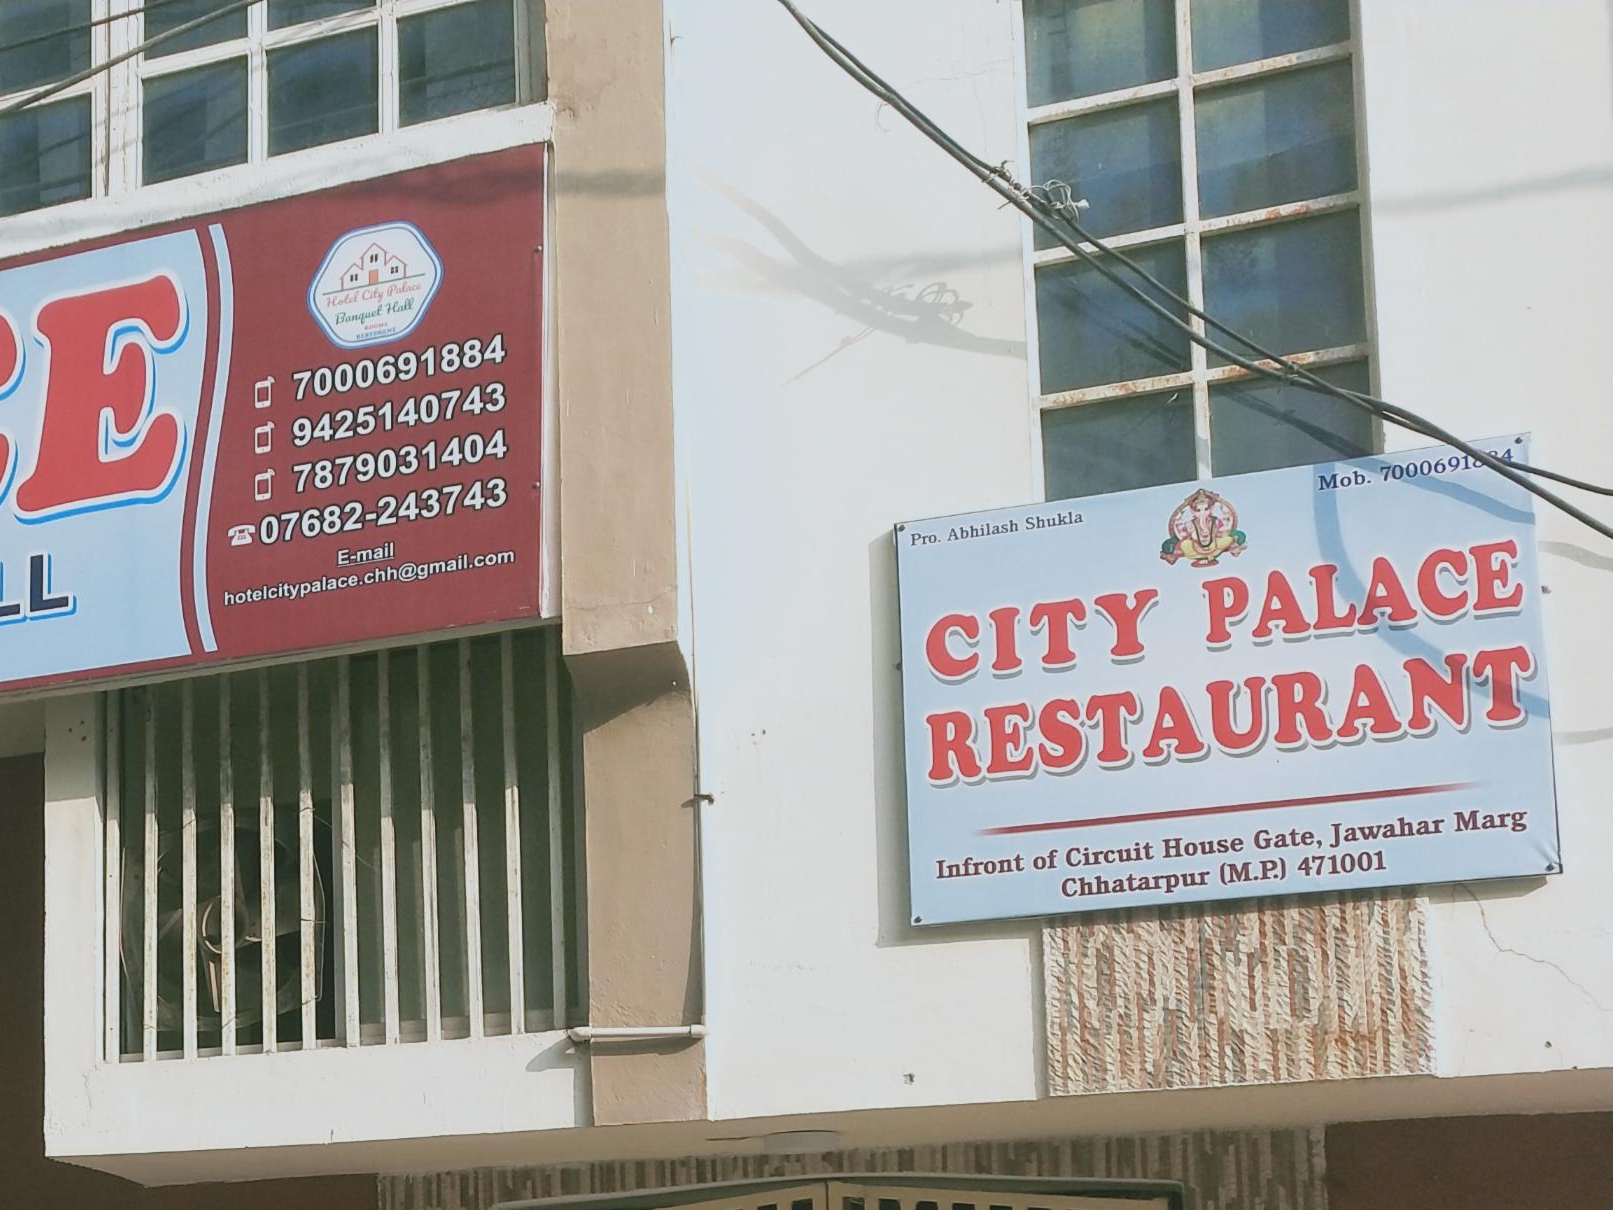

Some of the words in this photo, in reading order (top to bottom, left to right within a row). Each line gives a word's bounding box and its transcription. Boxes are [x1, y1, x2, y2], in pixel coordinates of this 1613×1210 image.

[326, 291, 359, 308] Hotel
[362, 289, 384, 303] City
[387, 282, 421, 297] Palace
[335, 304, 383, 325] Banquet
[385, 297, 415, 315] Hall
[292, 333, 507, 402] 7000691884
[291, 382, 507, 447] 9425140743
[292, 429, 508, 493] 7879031404
[1318, 470, 1371, 491] Mob.
[258, 477, 508, 545] 07682-243743
[910, 532, 941, 546] Pro.
[947, 519, 1019, 542] Abhilash
[1025, 511, 1084, 530] Shukla
[223, 550, 516, 606] hotelcitypalace.chh@gmail.com
[337, 542, 395, 567] E-mail
[924, 587, 1159, 680] CITY
[1202, 537, 1526, 647] PALACE
[925, 645, 1534, 784] RESTAURANT
[935, 852, 1025, 880] Infront
[1033, 849, 1058, 871] of
[1065, 841, 1154, 868] Circuit
[1162, 836, 1245, 859] House
[1253, 828, 1323, 850] Gate,
[1329, 815, 1445, 849] Jawahar
[1453, 809, 1528, 832] Marg
[1060, 867, 1211, 898] Chhatarpur
[1219, 857, 1287, 887] (M.P.)
[1296, 849, 1387, 878] 471001
